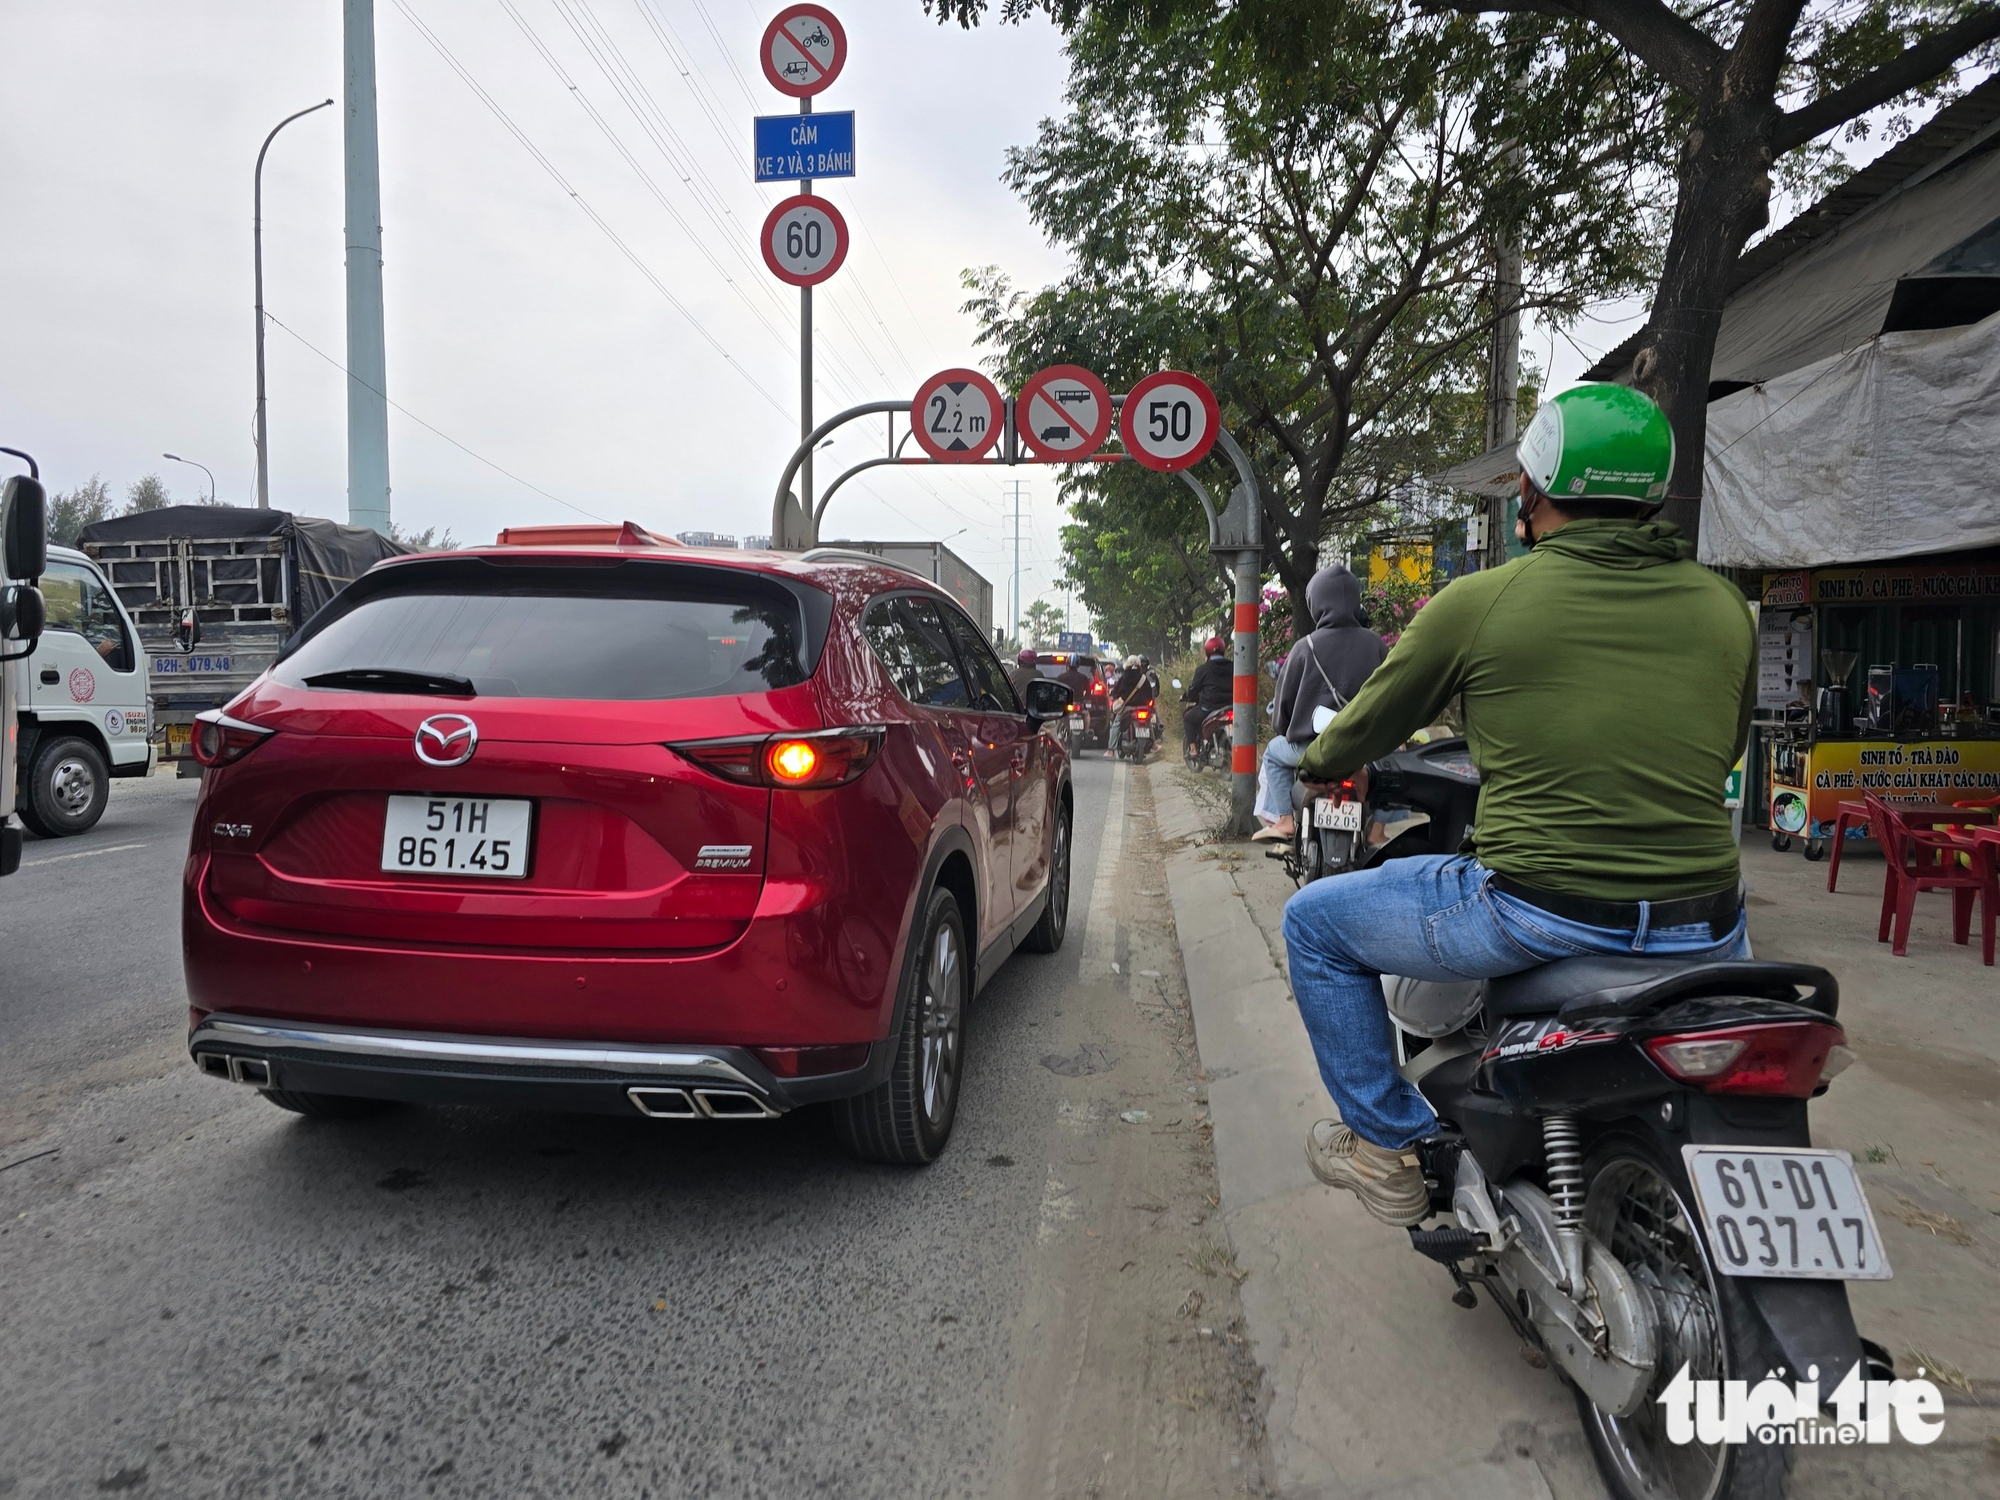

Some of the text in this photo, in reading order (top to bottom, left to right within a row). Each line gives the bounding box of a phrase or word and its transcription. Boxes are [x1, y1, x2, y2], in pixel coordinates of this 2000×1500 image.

[791, 117, 818, 146] CẤM
[758, 148, 852, 176] XE 2 VÀ 3 BÁNH
[786, 220, 822, 259] 60
[930, 395, 986, 434] 2.2 m
[1149, 400, 1192, 442] 50
[1769, 572, 1803, 590] SINH TỐ
[1818, 579, 1846, 598] SINH
[1848, 570, 1864, 598] TỐ
[1872, 572, 1888, 597] CÀ
[1891, 571, 1914, 597] PHÊ
[1922, 571, 1955, 596] NƯỚC
[1957, 568, 1982, 595] GIẢI
[1767, 588, 1804, 604] TRÀ ĐÀO
[189, 656, 230, 671] 079.48
[1860, 745, 1959, 765] SINH TỐ TRÀ ĐÀO
[1816, 770, 1831, 788] CÀ
[1834, 770, 1854, 788] PHÊ
[1862, 769, 1891, 788] NƯỚC
[1894, 768, 1917, 788] GIẢI
[1920, 769, 1951, 788] KHÁT
[1954, 769, 1975, 788] CÁC
[426, 801, 488, 834] 51H
[1317, 814, 1358, 829] 682.05
[398, 836, 511, 871] 861.45
[695, 858, 751, 869] PREMIUM
[1715, 1158, 1838, 1210] 61-D1
[1716, 1214, 1866, 1270] 037.17
